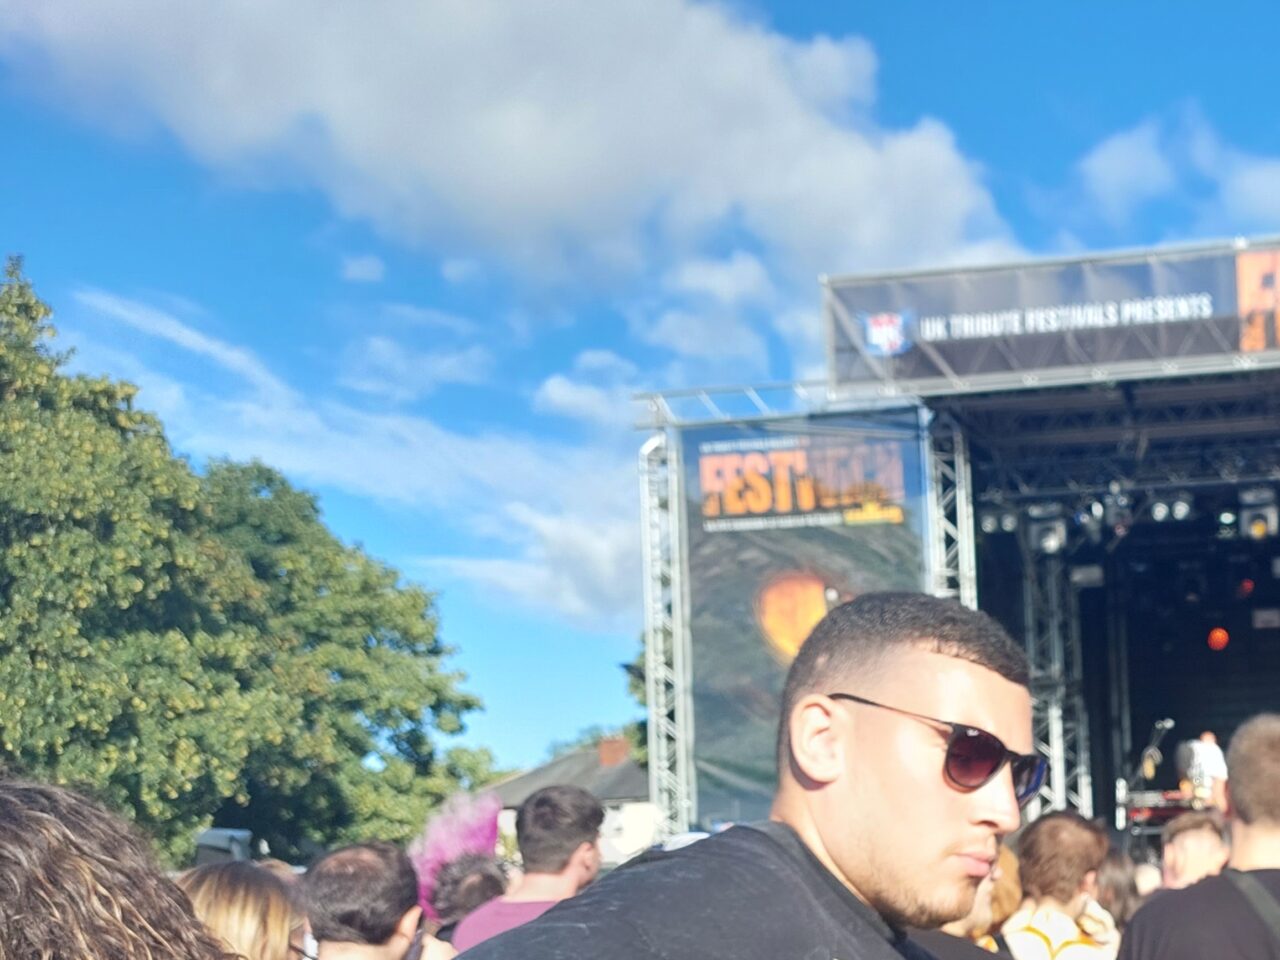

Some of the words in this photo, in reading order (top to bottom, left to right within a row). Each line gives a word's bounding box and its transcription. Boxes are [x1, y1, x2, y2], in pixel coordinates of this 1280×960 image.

[920, 316, 948, 341] UK
[950, 309, 1022, 339] TRIBUTE
[1024, 302, 1118, 335] FESTIVALS
[1120, 292, 1213, 327] PRESENTS
